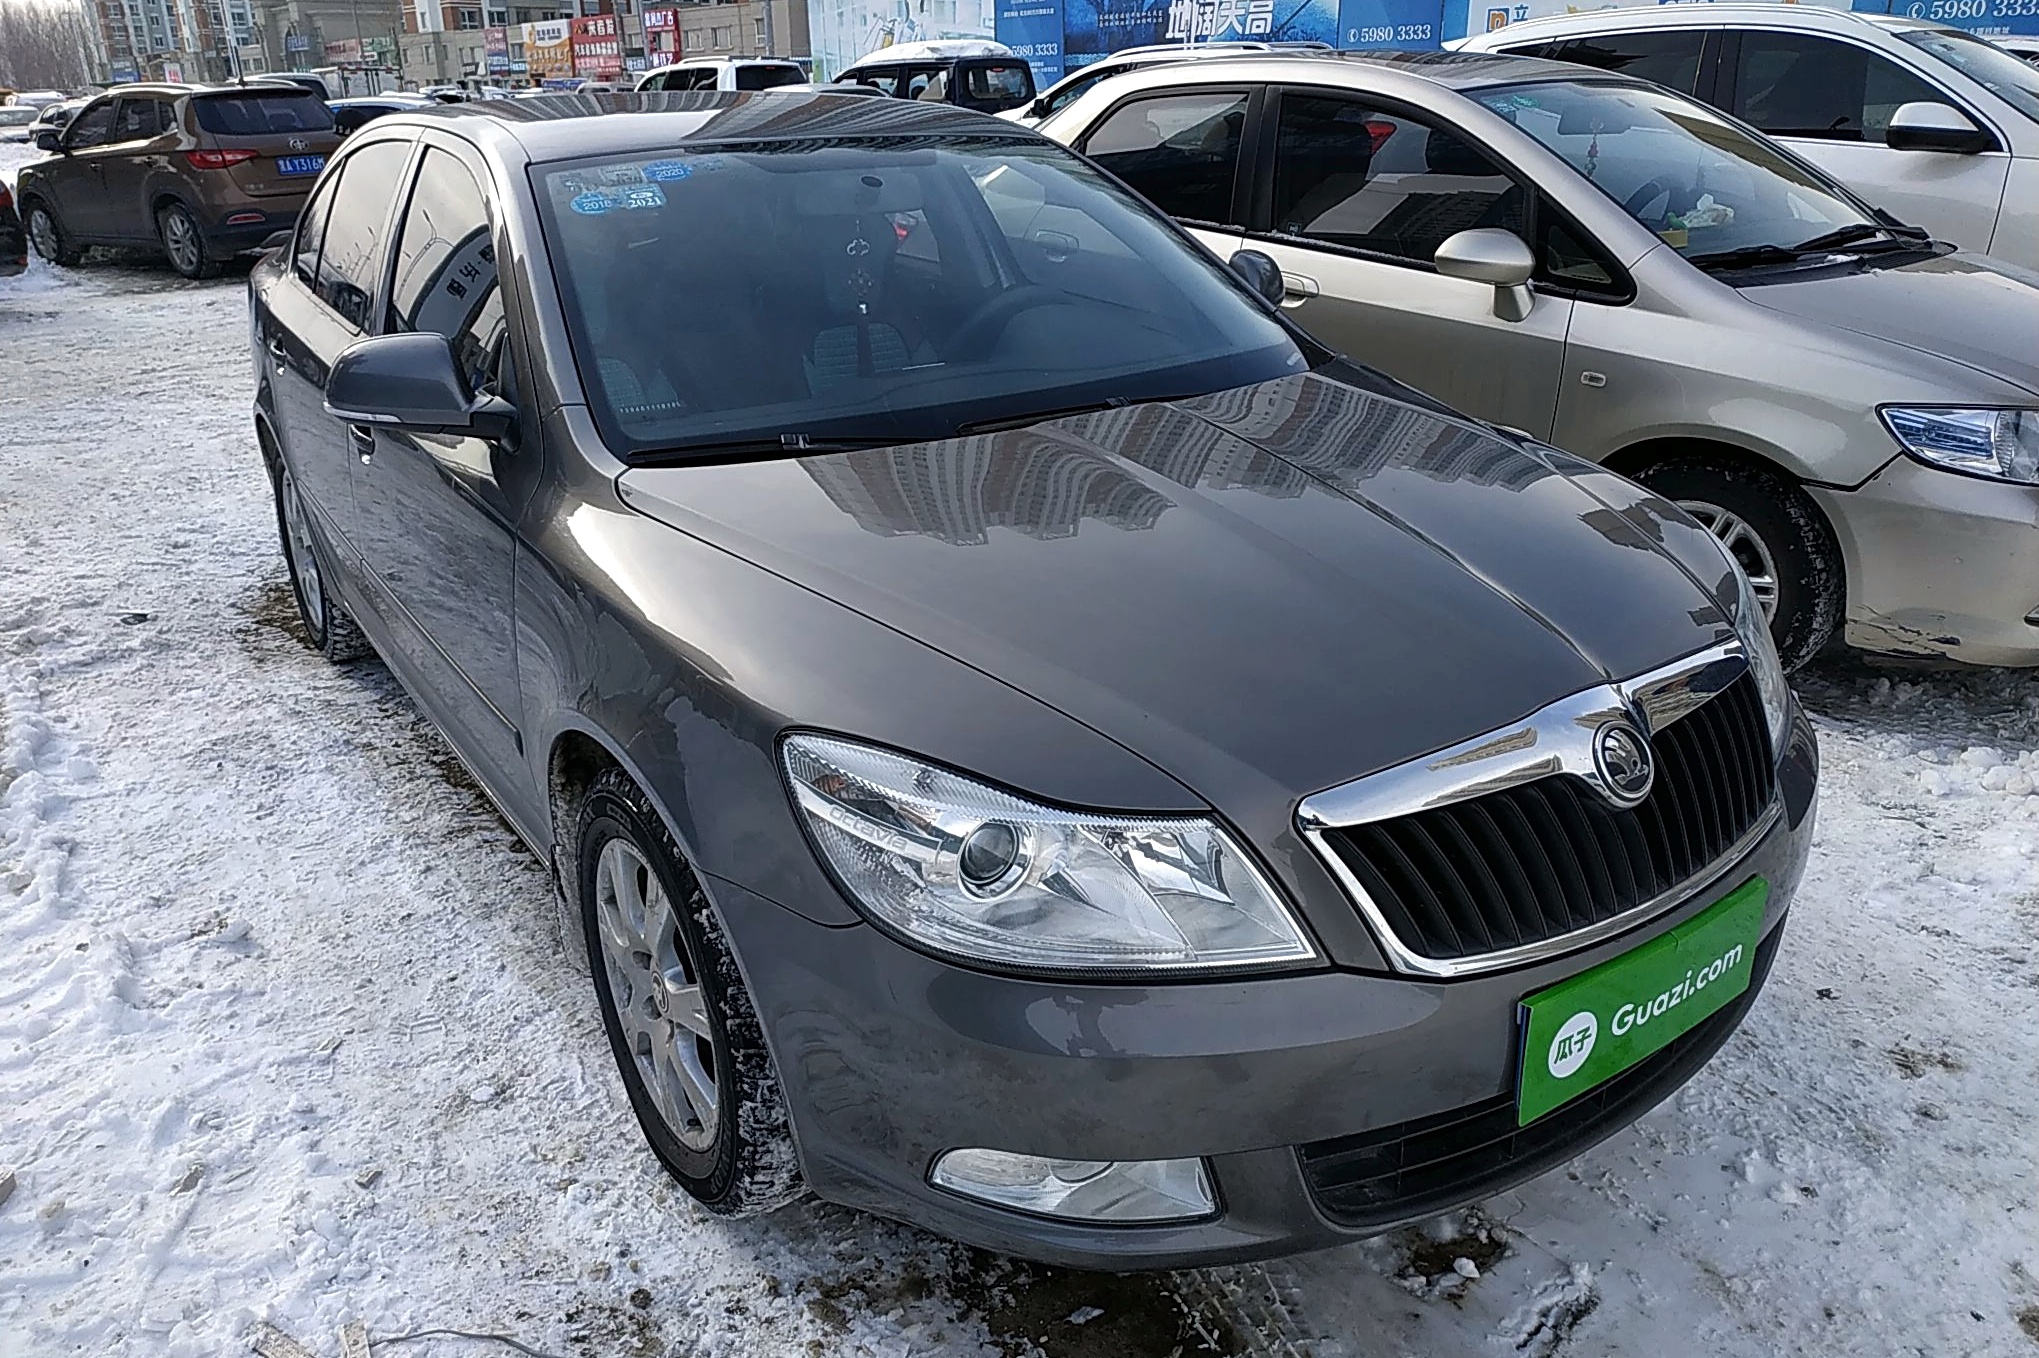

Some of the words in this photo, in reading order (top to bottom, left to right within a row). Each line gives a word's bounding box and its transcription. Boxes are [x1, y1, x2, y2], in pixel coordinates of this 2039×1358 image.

[1165, 0, 1274, 39] 地阔天高
[1929, 0, 1985, 20] 5980
[1992, 0, 2039, 17] 333
[1360, 26, 1394, 43] 5980
[1397, 24, 1431, 41] 3333
[1035, 43, 1058, 56] 3333
[656, 168, 684, 177] 2020
[628, 197, 661, 208] 2021
[829, 804, 908, 852] Octavia
[1611, 944, 1743, 1036] Guazi.com
